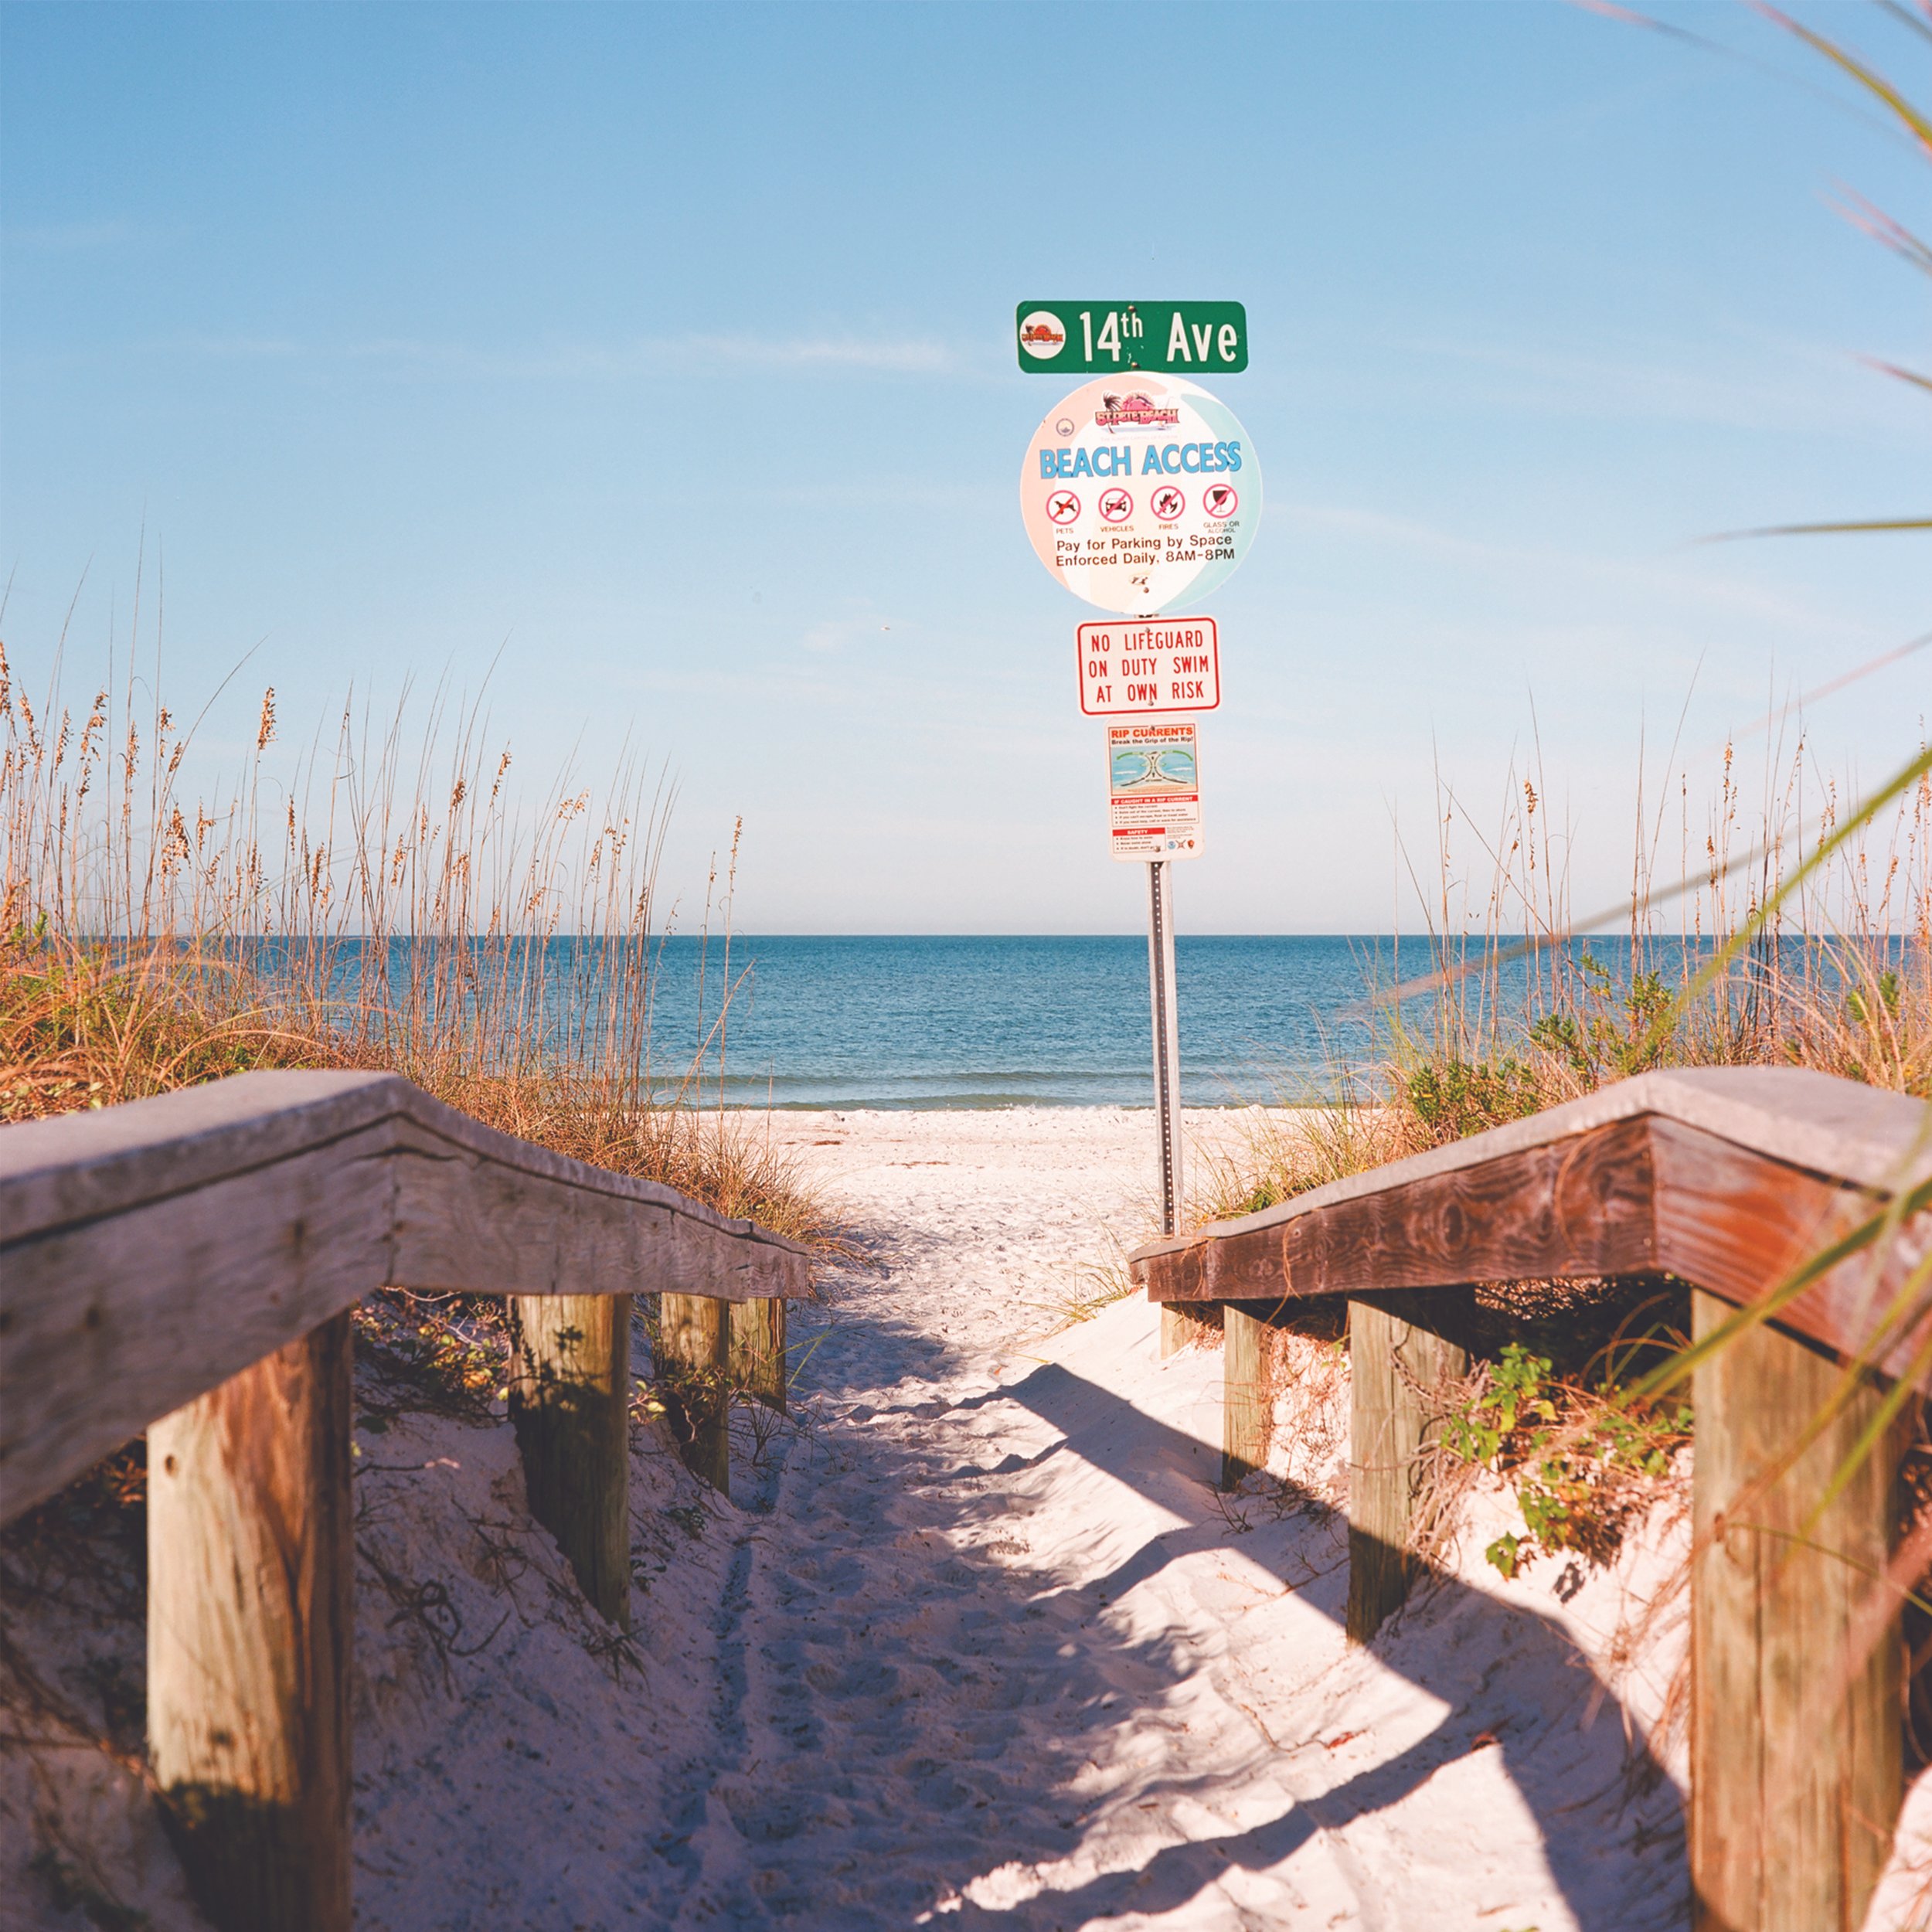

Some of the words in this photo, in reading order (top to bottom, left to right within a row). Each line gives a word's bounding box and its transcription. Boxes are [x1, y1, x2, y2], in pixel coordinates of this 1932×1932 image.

[1080, 311, 1143, 362] 14th
[1166, 312, 1237, 362] Ave
[1138, 409, 1180, 424] BEACH
[1039, 446, 1131, 479] BEACH
[1141, 440, 1242, 474] ACCESS
[1056, 540, 1080, 552] Pay
[1087, 539, 1105, 550] for
[1112, 537, 1161, 550] Parking
[1167, 536, 1183, 548] by
[1190, 534, 1232, 548] Space
[1056, 553, 1117, 567] Enforced
[1124, 553, 1160, 566] Daily,
[1165, 549, 1235, 562] 8AM-8PM
[1091, 634, 1110, 652] NO
[1124, 630, 1203, 651] LIFEGUARD
[1089, 660, 1107, 678] ON
[1122, 658, 1157, 676] DUTY
[1173, 655, 1209, 674] SWIM
[1097, 685, 1112, 703] AT
[1128, 683, 1158, 701] OWN
[1172, 681, 1204, 699] RISK
[1111, 730, 1129, 738] RIP
[1133, 727, 1192, 737] CURRENTS
